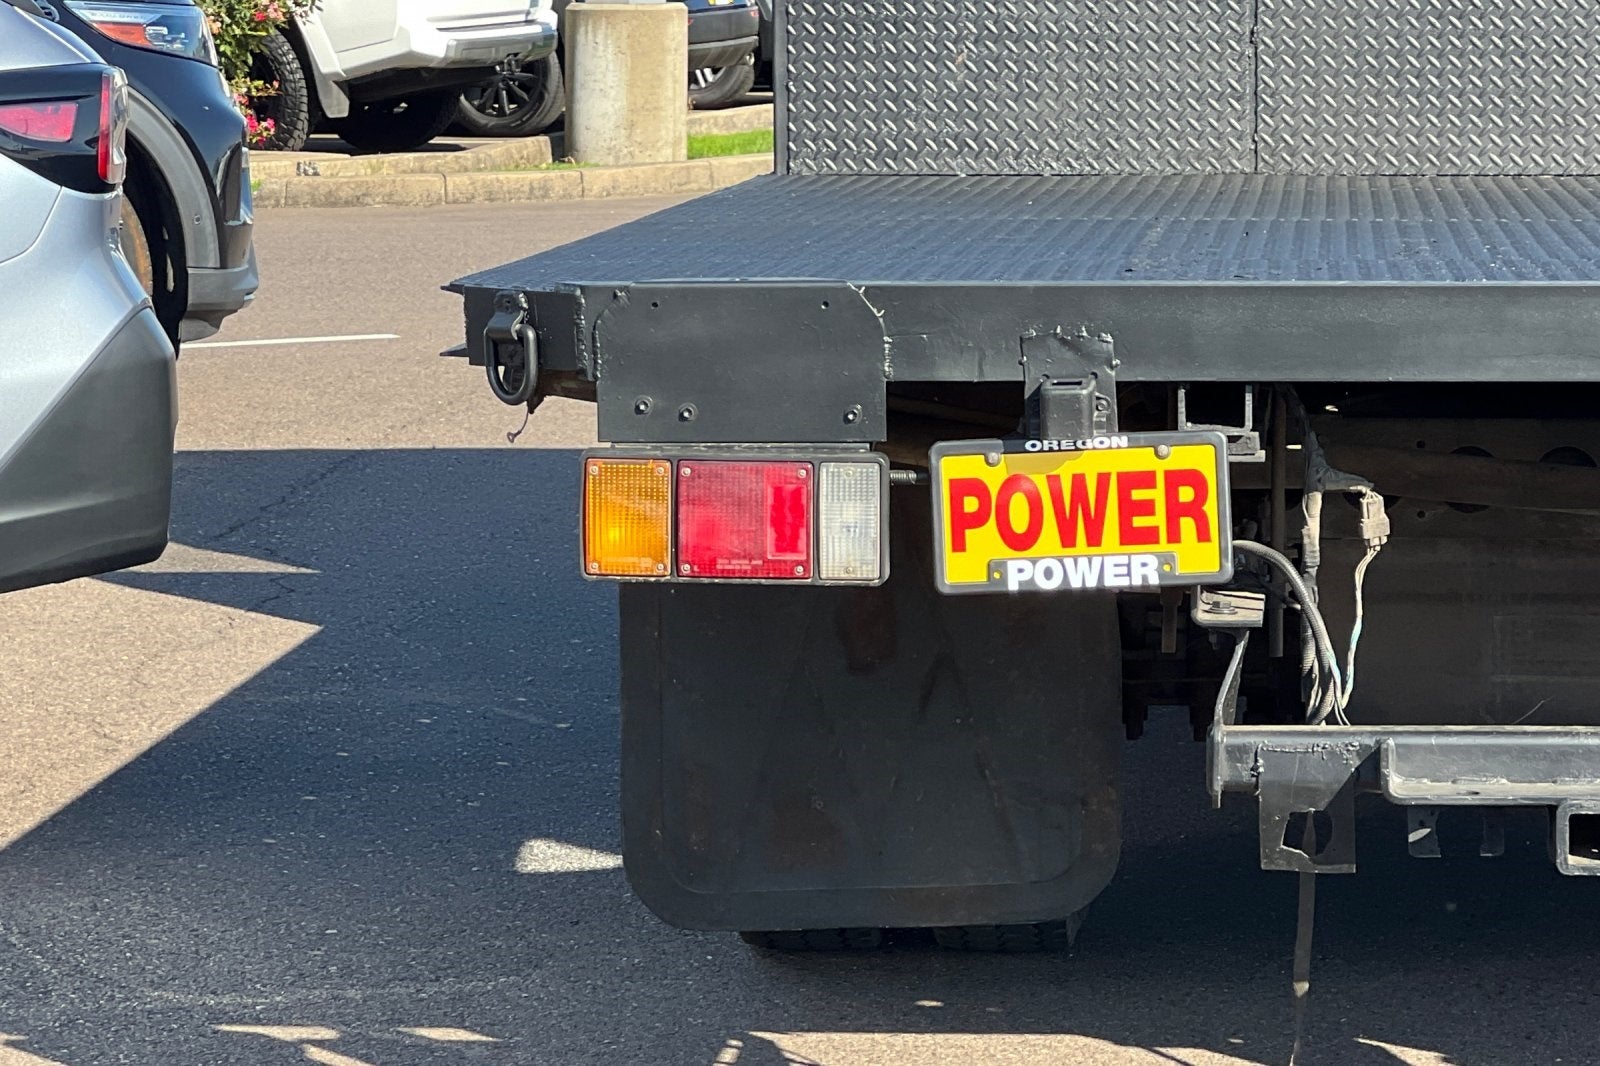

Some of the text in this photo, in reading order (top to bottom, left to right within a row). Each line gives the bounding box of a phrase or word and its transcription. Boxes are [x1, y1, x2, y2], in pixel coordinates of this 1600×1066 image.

[1024, 436, 1128, 452] OREGON
[949, 468, 1212, 553] POWER
[1007, 554, 1160, 591] POWER
